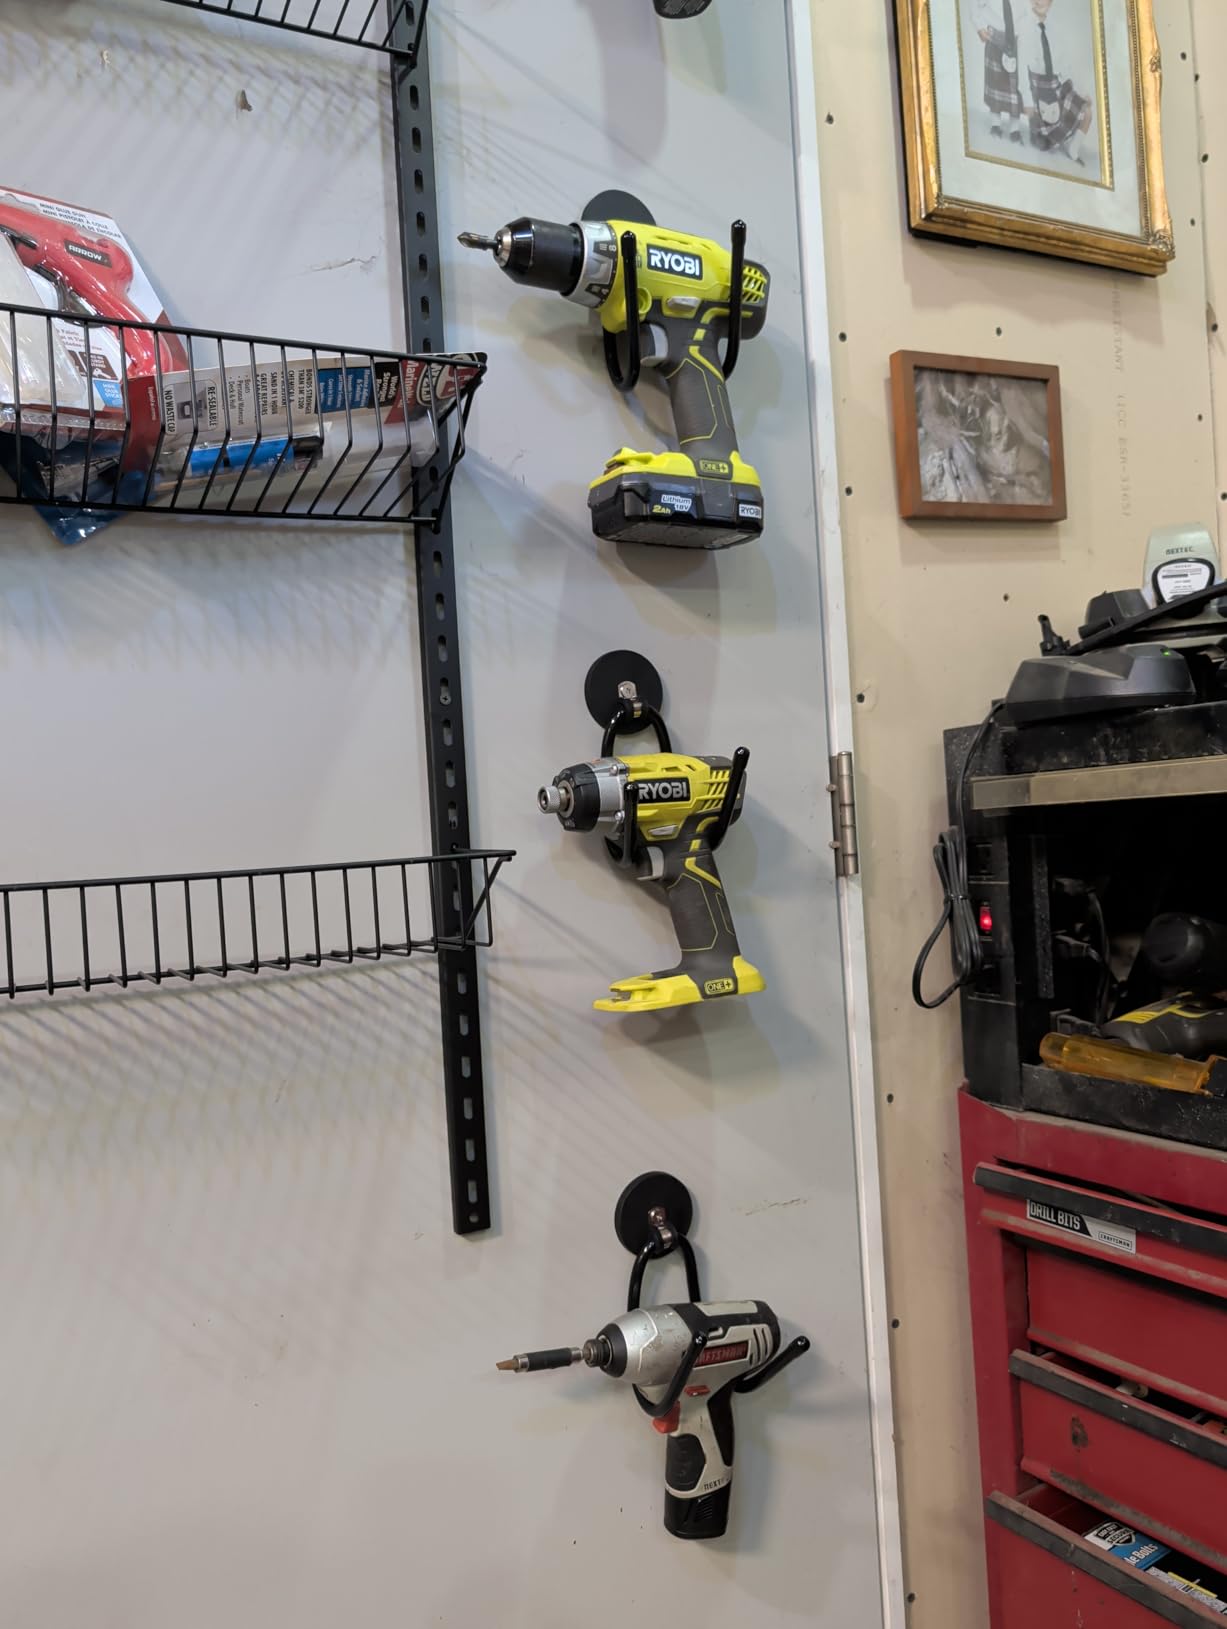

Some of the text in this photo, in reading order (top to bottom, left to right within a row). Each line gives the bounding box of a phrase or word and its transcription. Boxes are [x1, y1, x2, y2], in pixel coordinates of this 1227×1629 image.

[68, 244, 102, 261] ARROW
[649, 248, 700, 276] RYOBI
[260, 373, 268, 391] GREAT
[305, 368, 313, 414] BONDS STRONGER
[387, 375, 399, 399] World's
[165, 390, 176, 433] NO WASTE CAP
[208, 386, 217, 426] RE-SEALABLE
[663, 494, 692, 505] Lithium
[676, 504, 690, 512] 18V
[652, 505, 671, 514] 2Ah
[740, 504, 761, 517] RYOBI
[638, 782, 688, 800] RYOBI
[1030, 1202, 1081, 1231] DRILL BITS
[1100, 1232, 1130, 1248] CRAFTSMAN
[1132, 1544, 1159, 1560] Bolts
